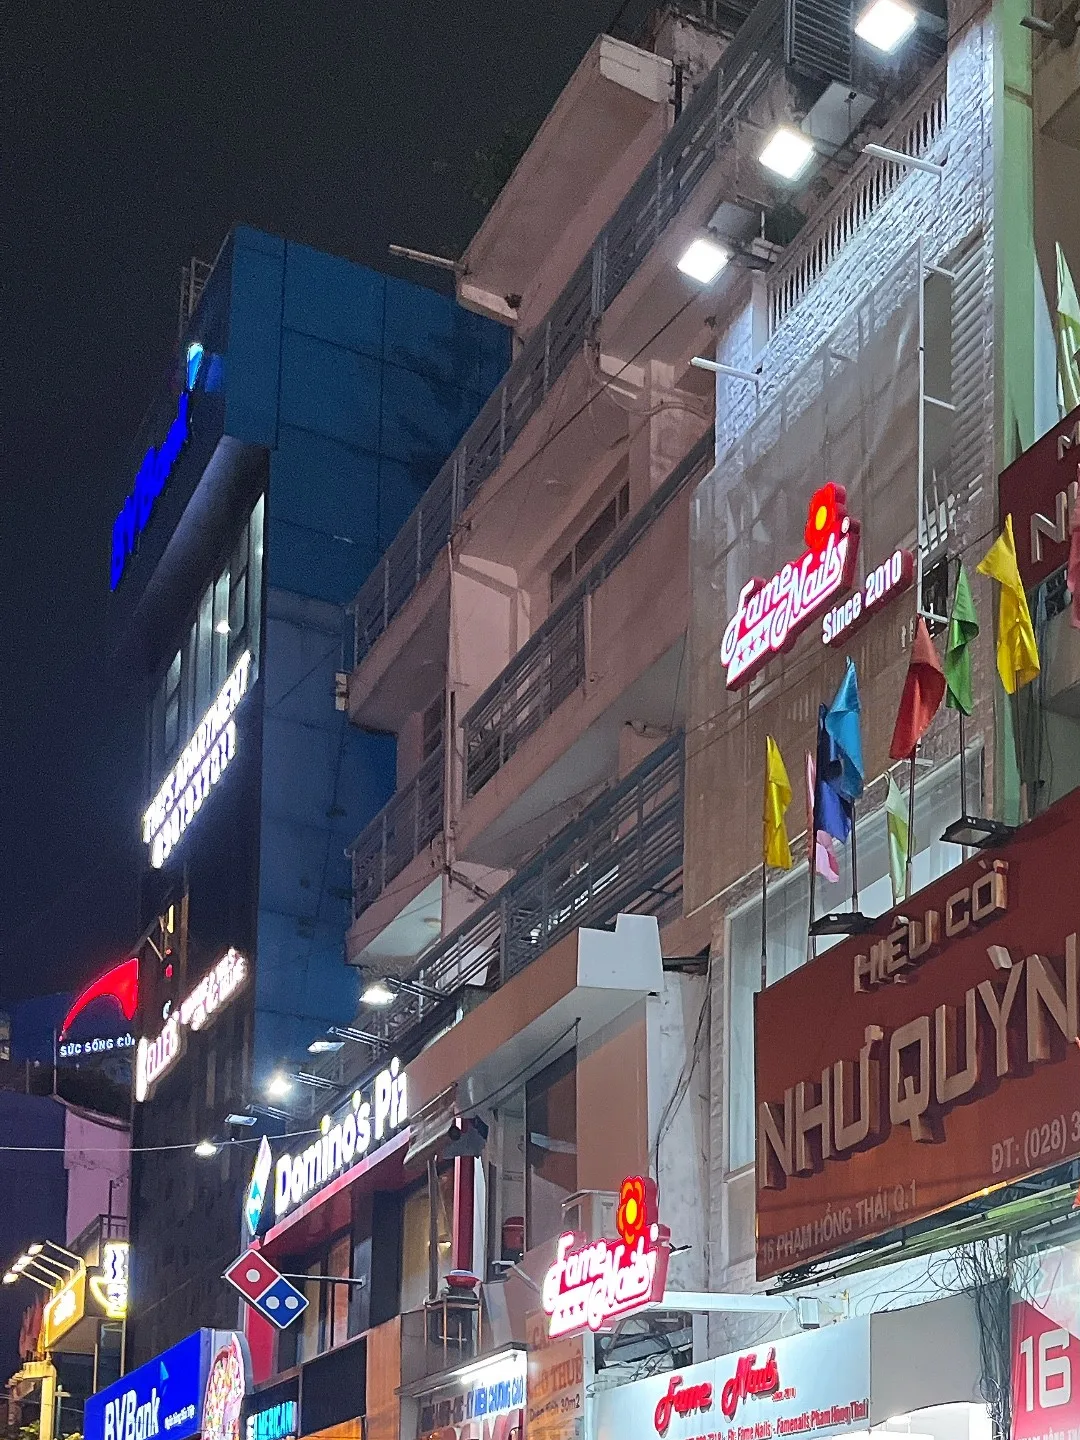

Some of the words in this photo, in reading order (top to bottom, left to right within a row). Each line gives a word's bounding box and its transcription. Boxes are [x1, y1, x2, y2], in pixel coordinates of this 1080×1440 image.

[769, 532, 849, 649] Nails
[822, 592, 862, 644] Since
[865, 550, 902, 607] 2010
[853, 909, 940, 994] HIỆU
[274, 1090, 371, 1216] Domino's
[759, 1024, 885, 1190] NHƯ
[1024, 1117, 1068, 1163] (028)
[776, 1221, 813, 1260] PHẠM
[813, 1203, 853, 1241] HỒNG
[654, 1375, 714, 1438] Fame
[721, 1346, 780, 1424] Nails
[1020, 1328, 1071, 1413] 16
